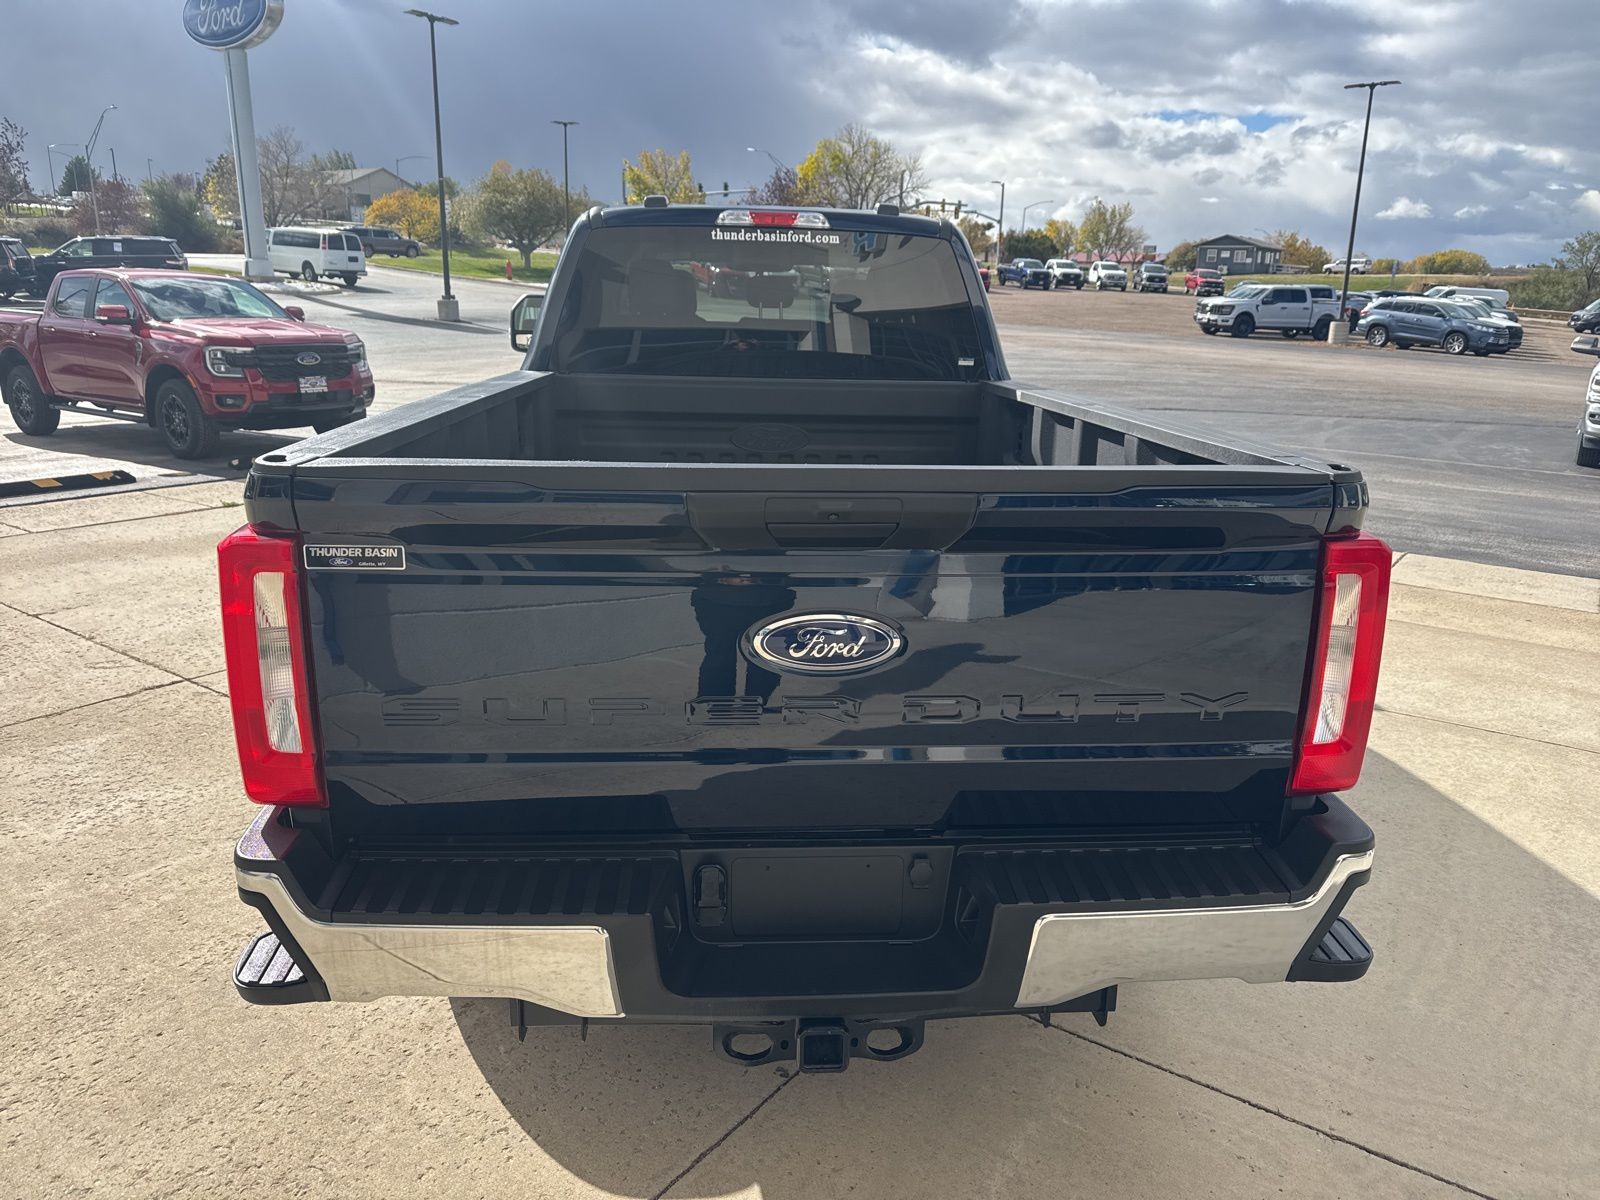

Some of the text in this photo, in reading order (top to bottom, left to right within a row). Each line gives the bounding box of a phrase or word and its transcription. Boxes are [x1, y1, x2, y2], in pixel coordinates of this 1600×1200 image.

[197, 0, 246, 34] Ford
[710, 228, 841, 244] thunderbasinford.com
[308, 547, 398, 557] THUNDER BASIN
[788, 626, 868, 658] Ford
[381, 691, 1249, 727] SUPER DUTY
